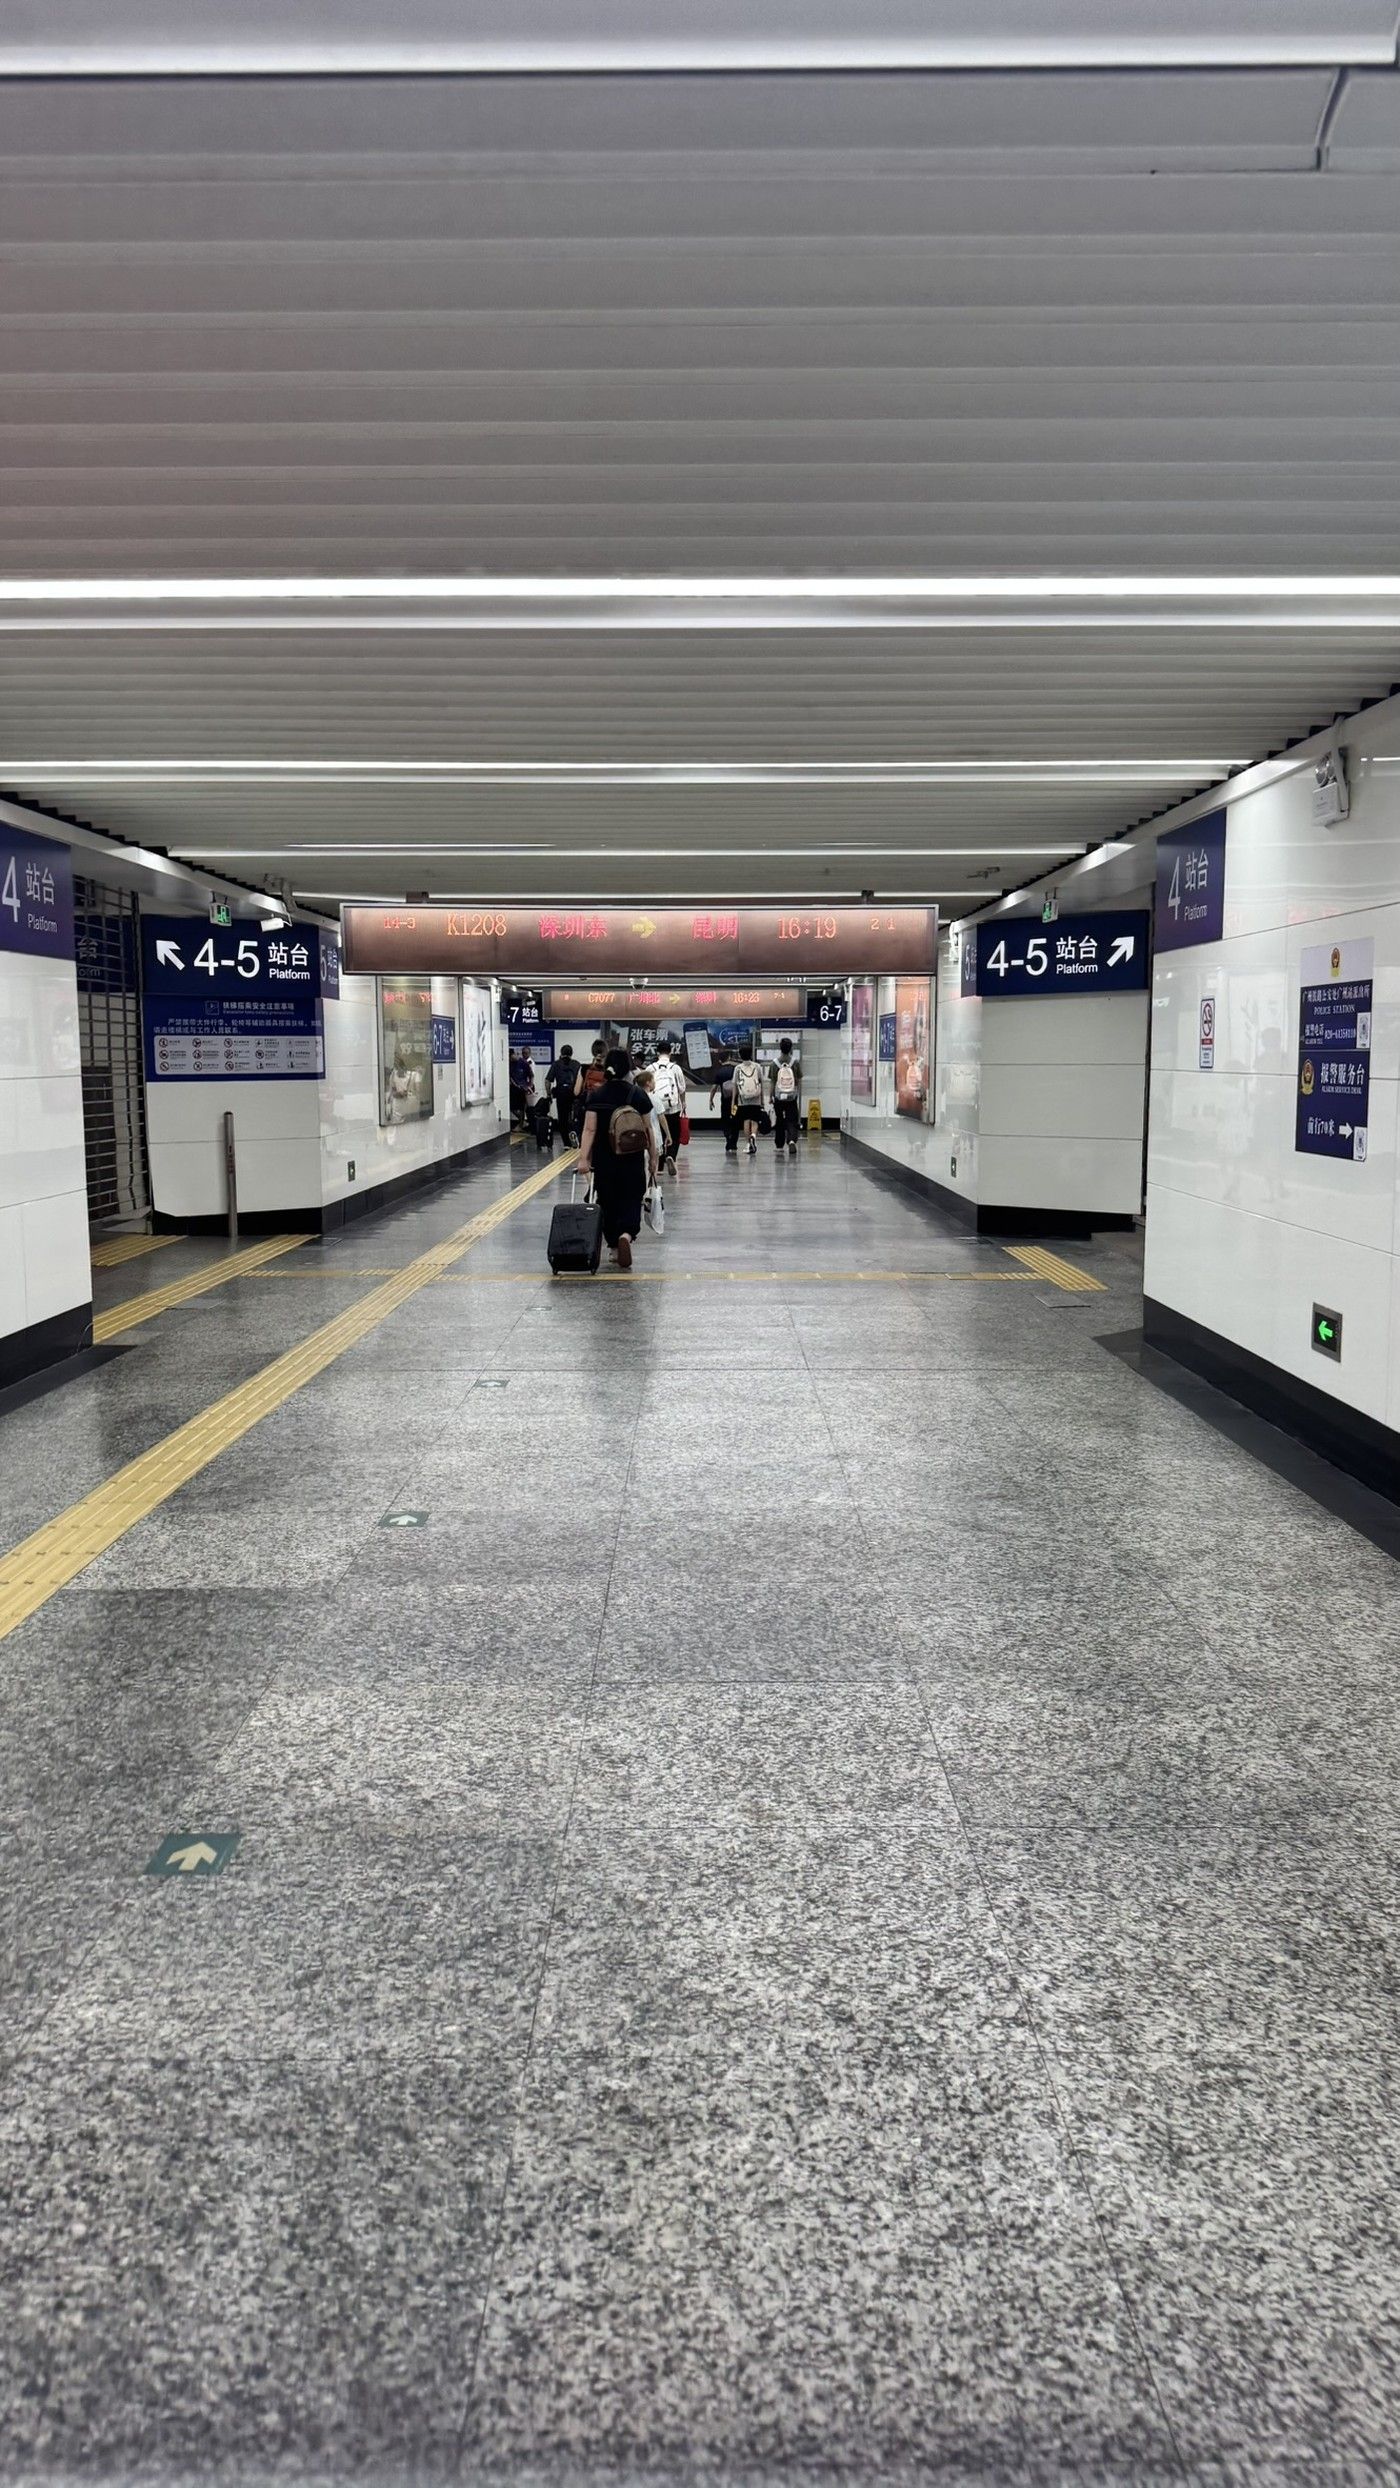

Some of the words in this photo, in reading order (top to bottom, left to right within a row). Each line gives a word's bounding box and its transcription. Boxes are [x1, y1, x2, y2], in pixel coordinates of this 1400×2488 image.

[1, 856, 21, 923] 4
[25, 861, 55, 905] 站台
[1168, 856, 1181, 921] 4
[1185, 848, 1209, 891] 站台
[1184, 903, 1208, 922] Platform
[27, 913, 58, 934] Platform
[447, 913, 508, 937] K1208
[538, 915, 608, 940] 深圳东
[691, 916, 739, 940] 昆明
[777, 916, 837, 940] 16:19
[193, 938, 260, 978] 4-5
[268, 942, 310, 967] 站台
[986, 937, 1048, 977] 4-5
[1055, 935, 1098, 960] 站台
[268, 967, 311, 980] Platform
[1056, 962, 1098, 975] Platform
[522, 1007, 538, 1018] 站台
[819, 1005, 842, 1022] 6-7
[1313, 1005, 1331, 1015] POLICE
[1332, 1004, 1355, 1014] STATION
[630, 1042, 682, 1055] 全天效
[1320, 1062, 1365, 1085] 报警服务台
